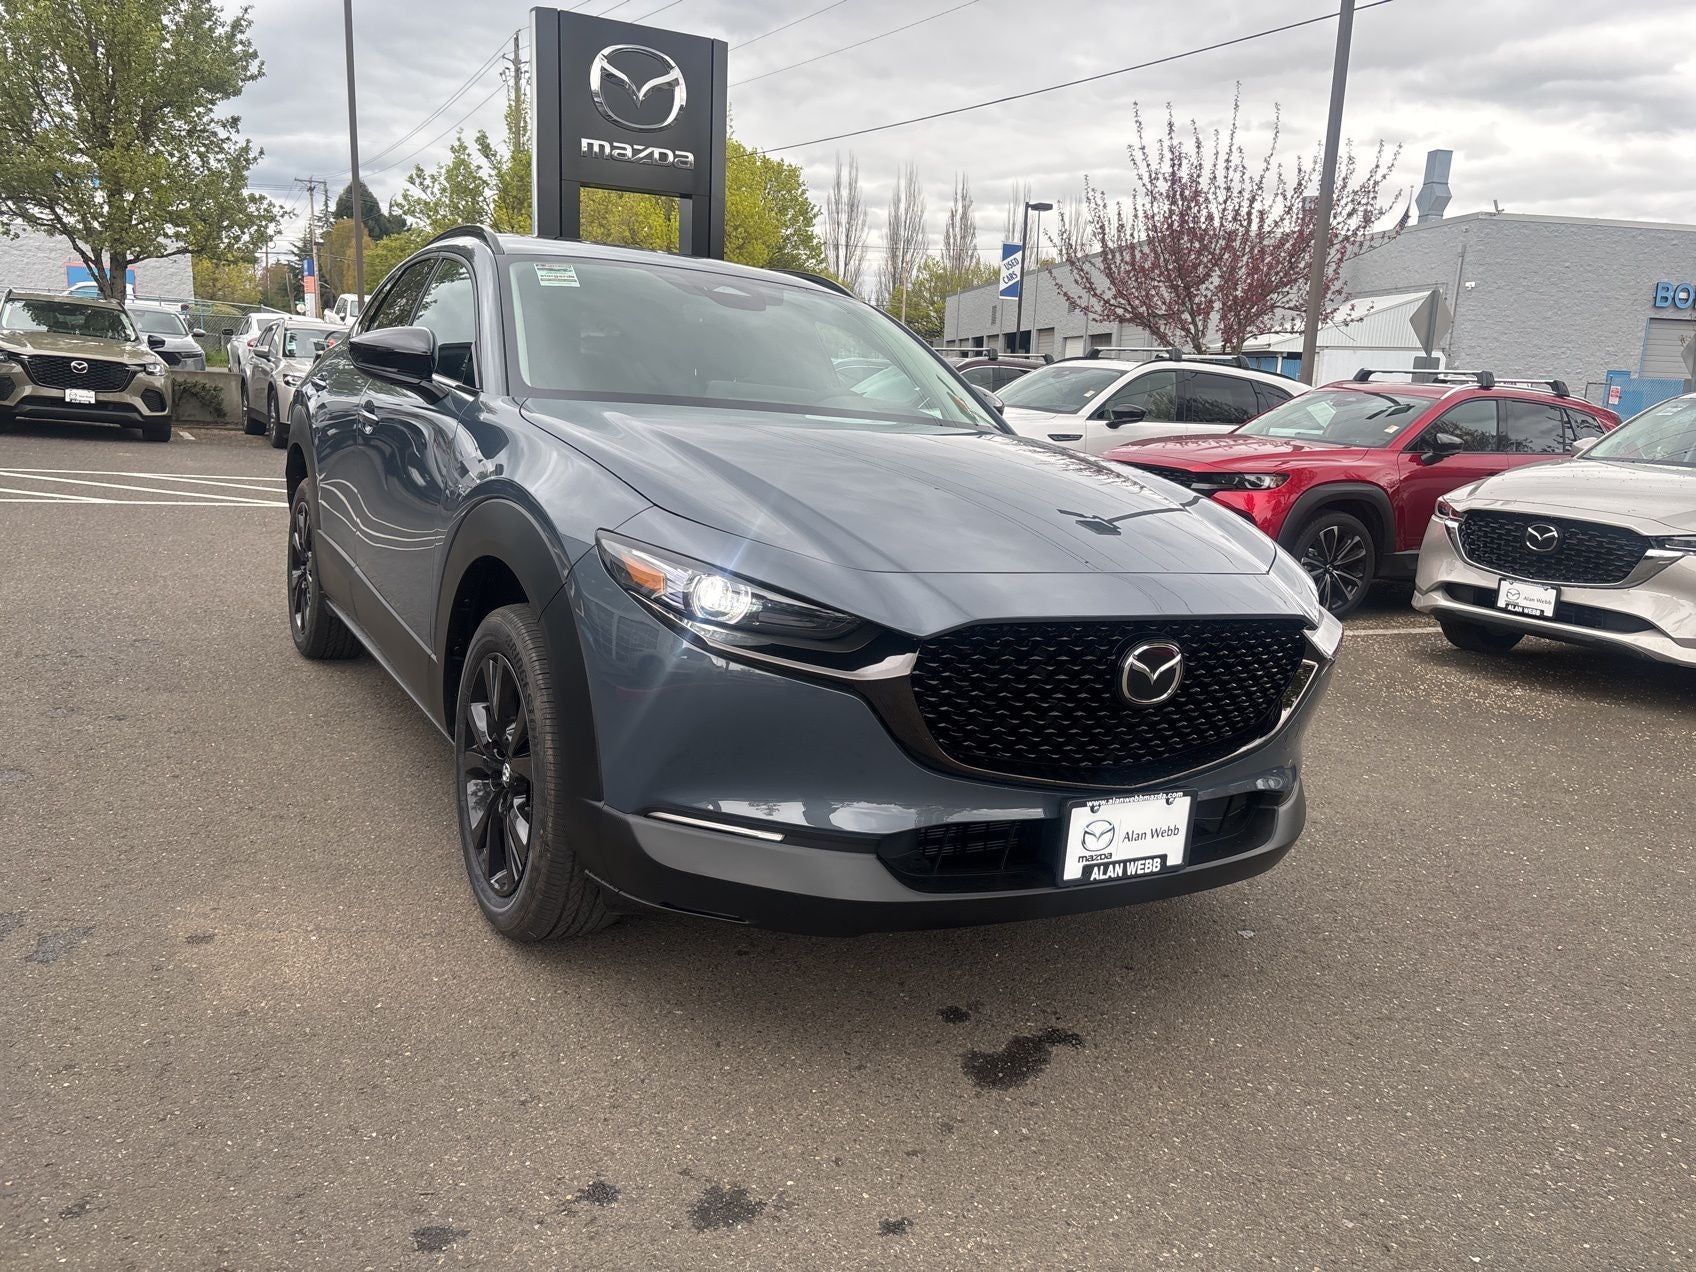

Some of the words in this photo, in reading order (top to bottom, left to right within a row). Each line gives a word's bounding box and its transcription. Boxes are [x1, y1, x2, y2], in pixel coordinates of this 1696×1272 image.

[1003, 257, 1019, 270] USED
[1002, 271, 1018, 284] CARS
[1654, 281, 1696, 310] BO
[1508, 604, 1522, 612] ALAN
[1087, 792, 1183, 806] www.alanwebbmazda.com
[1122, 830, 1147, 843] Alan
[1150, 824, 1180, 839] Webb
[1078, 852, 1112, 864] mazda
[1090, 863, 1124, 881] ALAN
[1126, 859, 1161, 875] WEBB
